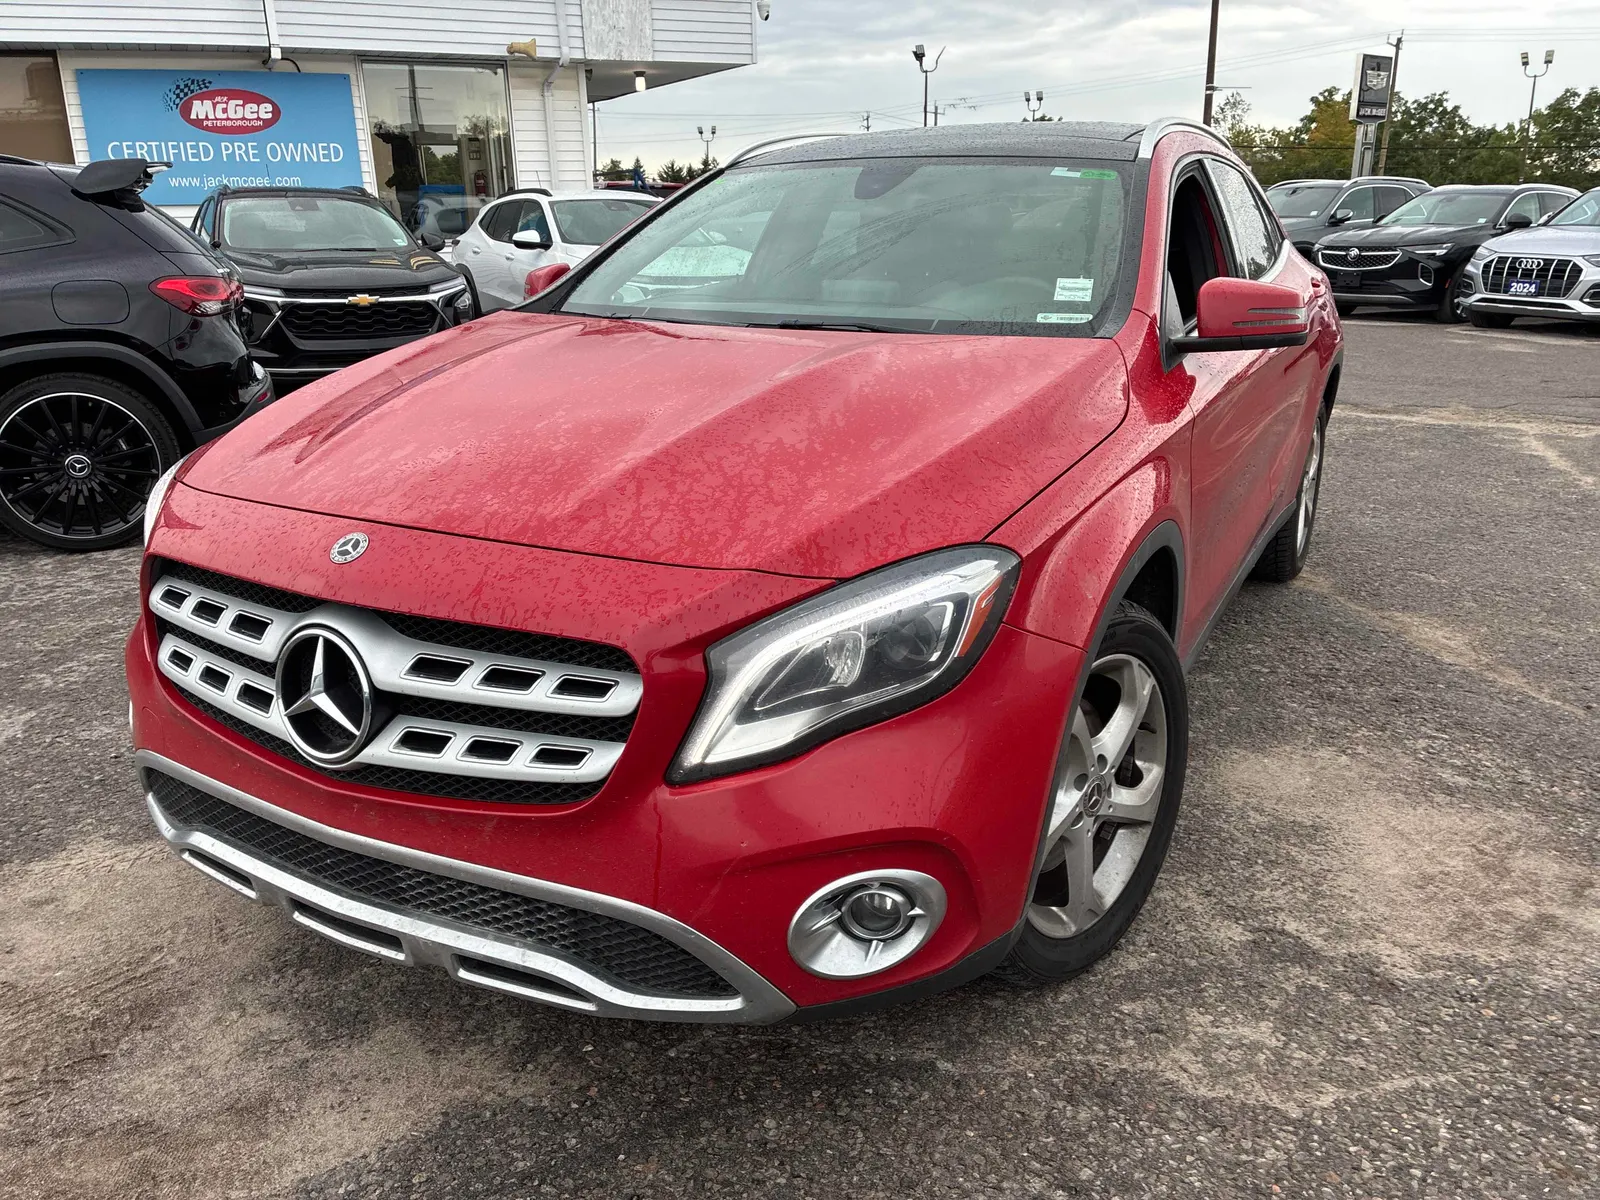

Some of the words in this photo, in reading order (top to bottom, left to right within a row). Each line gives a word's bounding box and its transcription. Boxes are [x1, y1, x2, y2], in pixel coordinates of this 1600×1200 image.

[190, 100, 273, 119] McGee
[107, 141, 214, 162] CERTIFIED
[221, 142, 260, 162] PRE
[266, 142, 344, 162] OWNED
[1510, 282, 1536, 293] 2024
